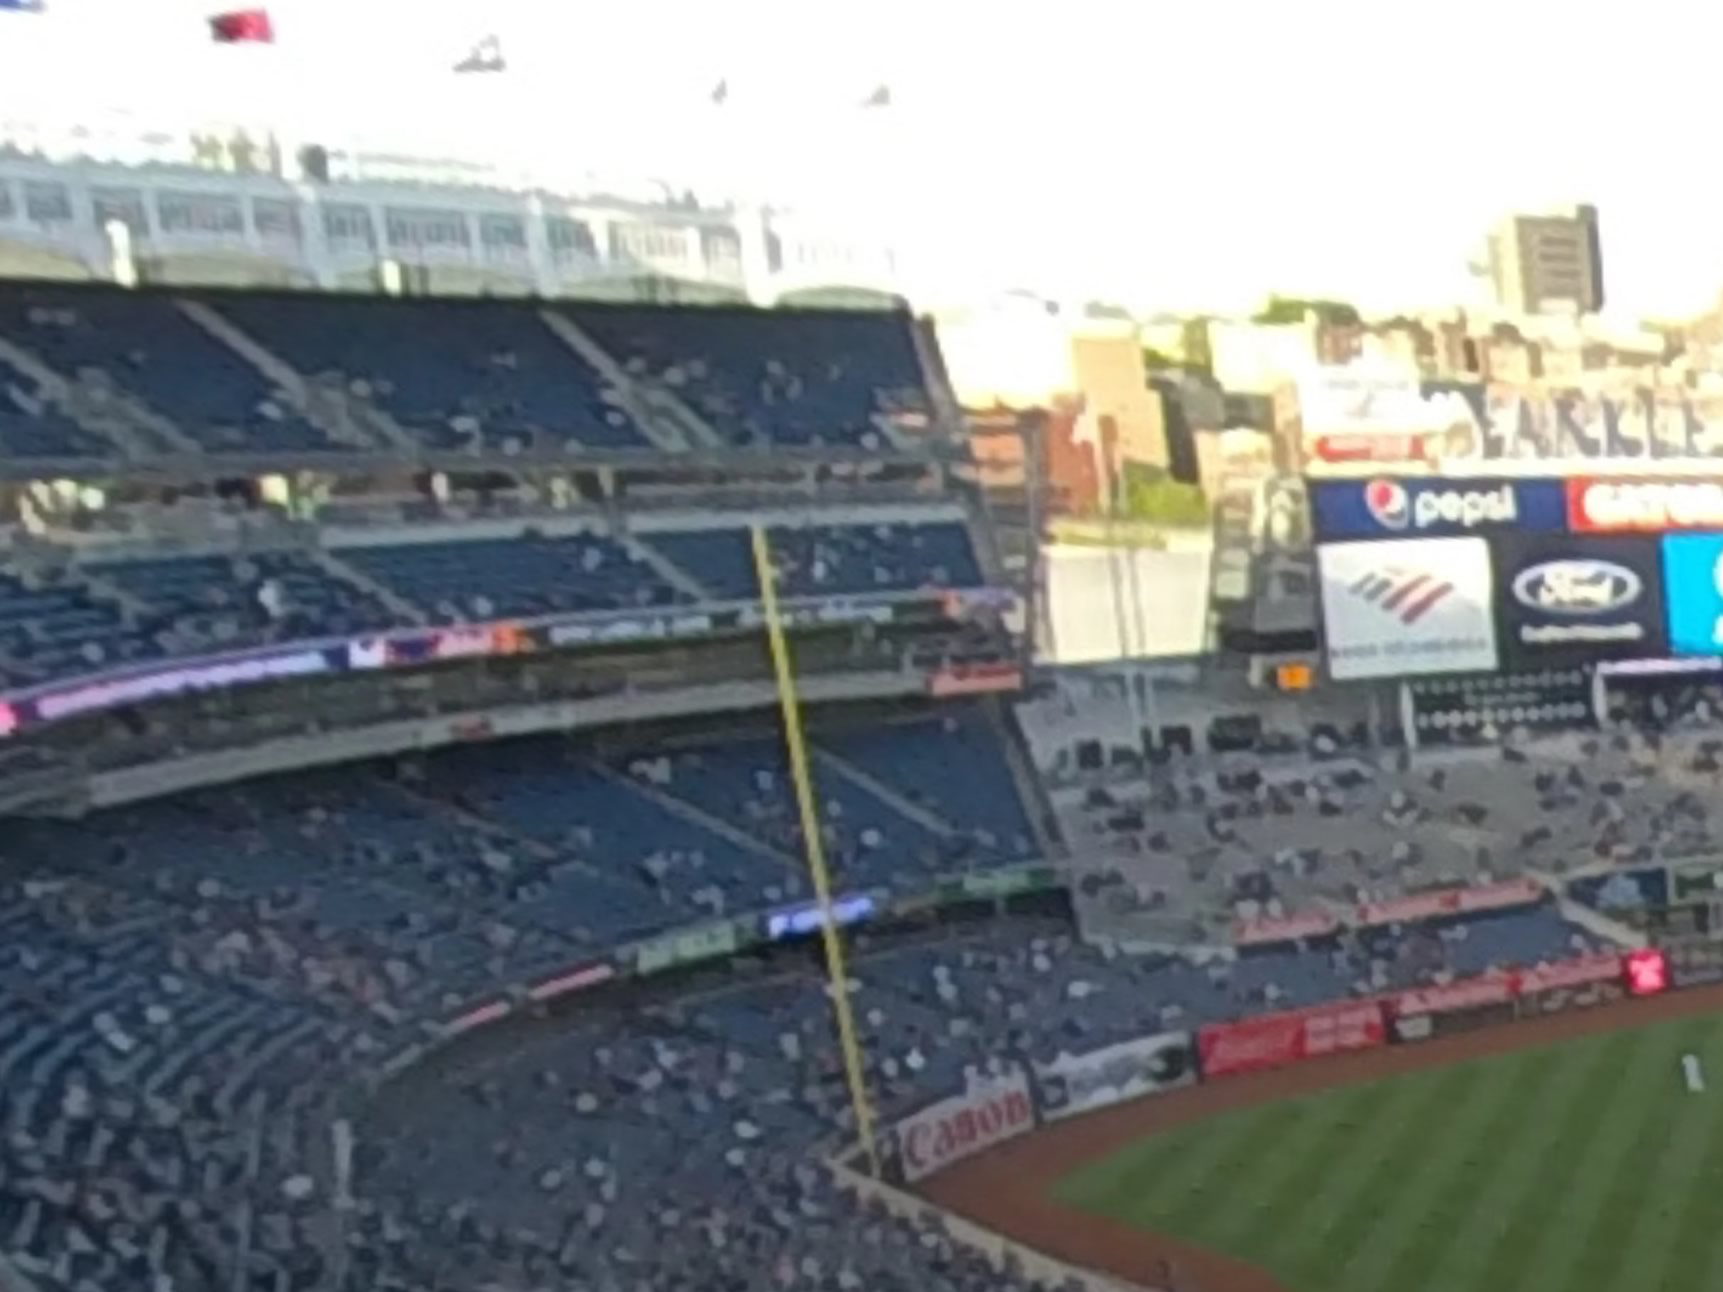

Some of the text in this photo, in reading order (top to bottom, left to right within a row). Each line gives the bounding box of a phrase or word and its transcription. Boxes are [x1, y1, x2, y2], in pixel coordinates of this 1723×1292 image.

[1414, 482, 1517, 527] pepsi
[1537, 566, 1614, 606] Ford
[901, 1087, 1030, 1170] Canon
